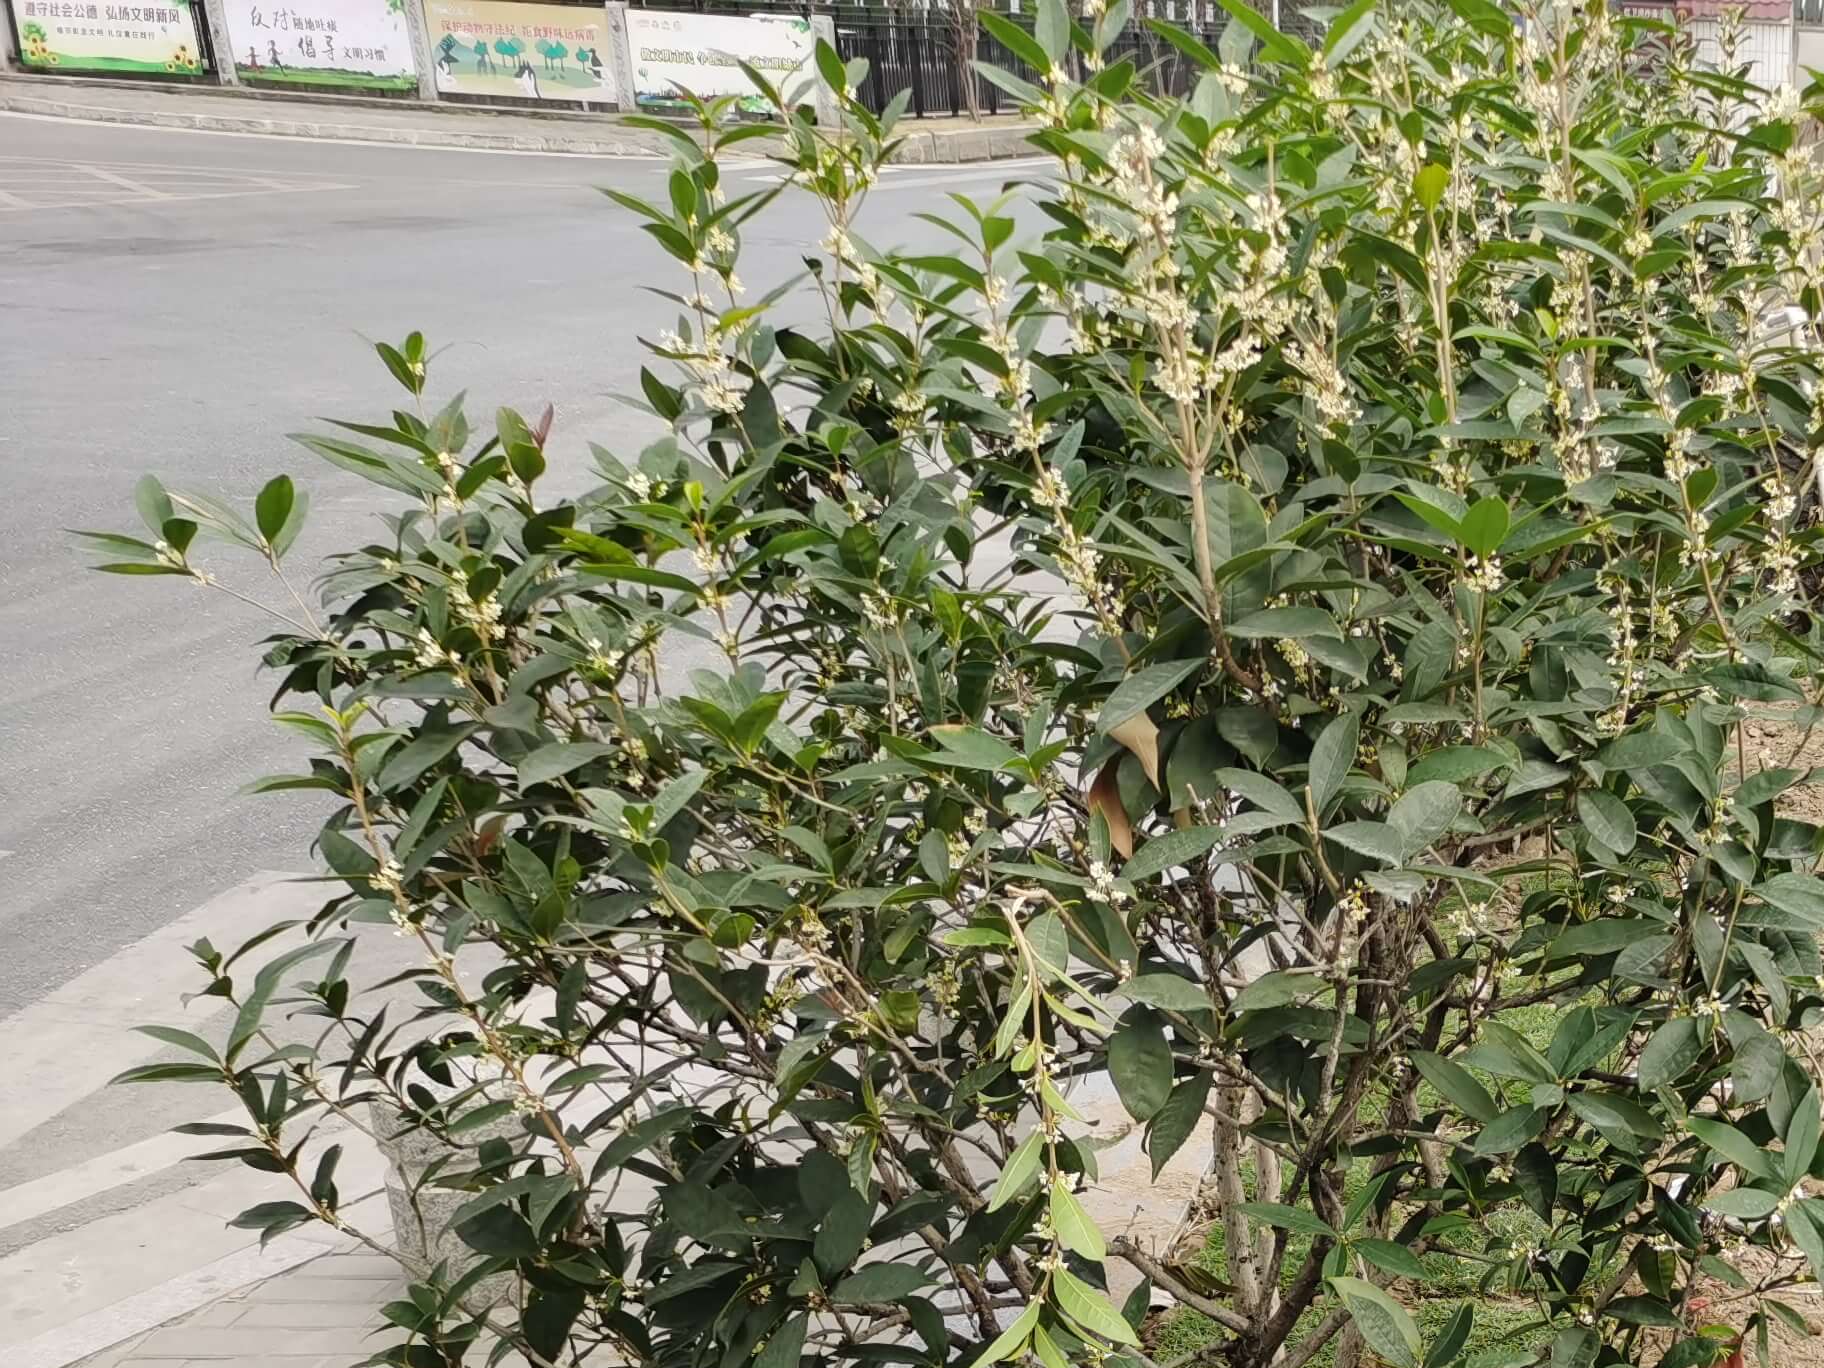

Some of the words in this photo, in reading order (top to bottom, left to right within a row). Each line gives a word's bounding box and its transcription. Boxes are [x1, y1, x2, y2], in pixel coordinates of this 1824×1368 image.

[24, 1, 98, 20] 遵守社会公德
[104, 5, 181, 24] 弘扬文明新风
